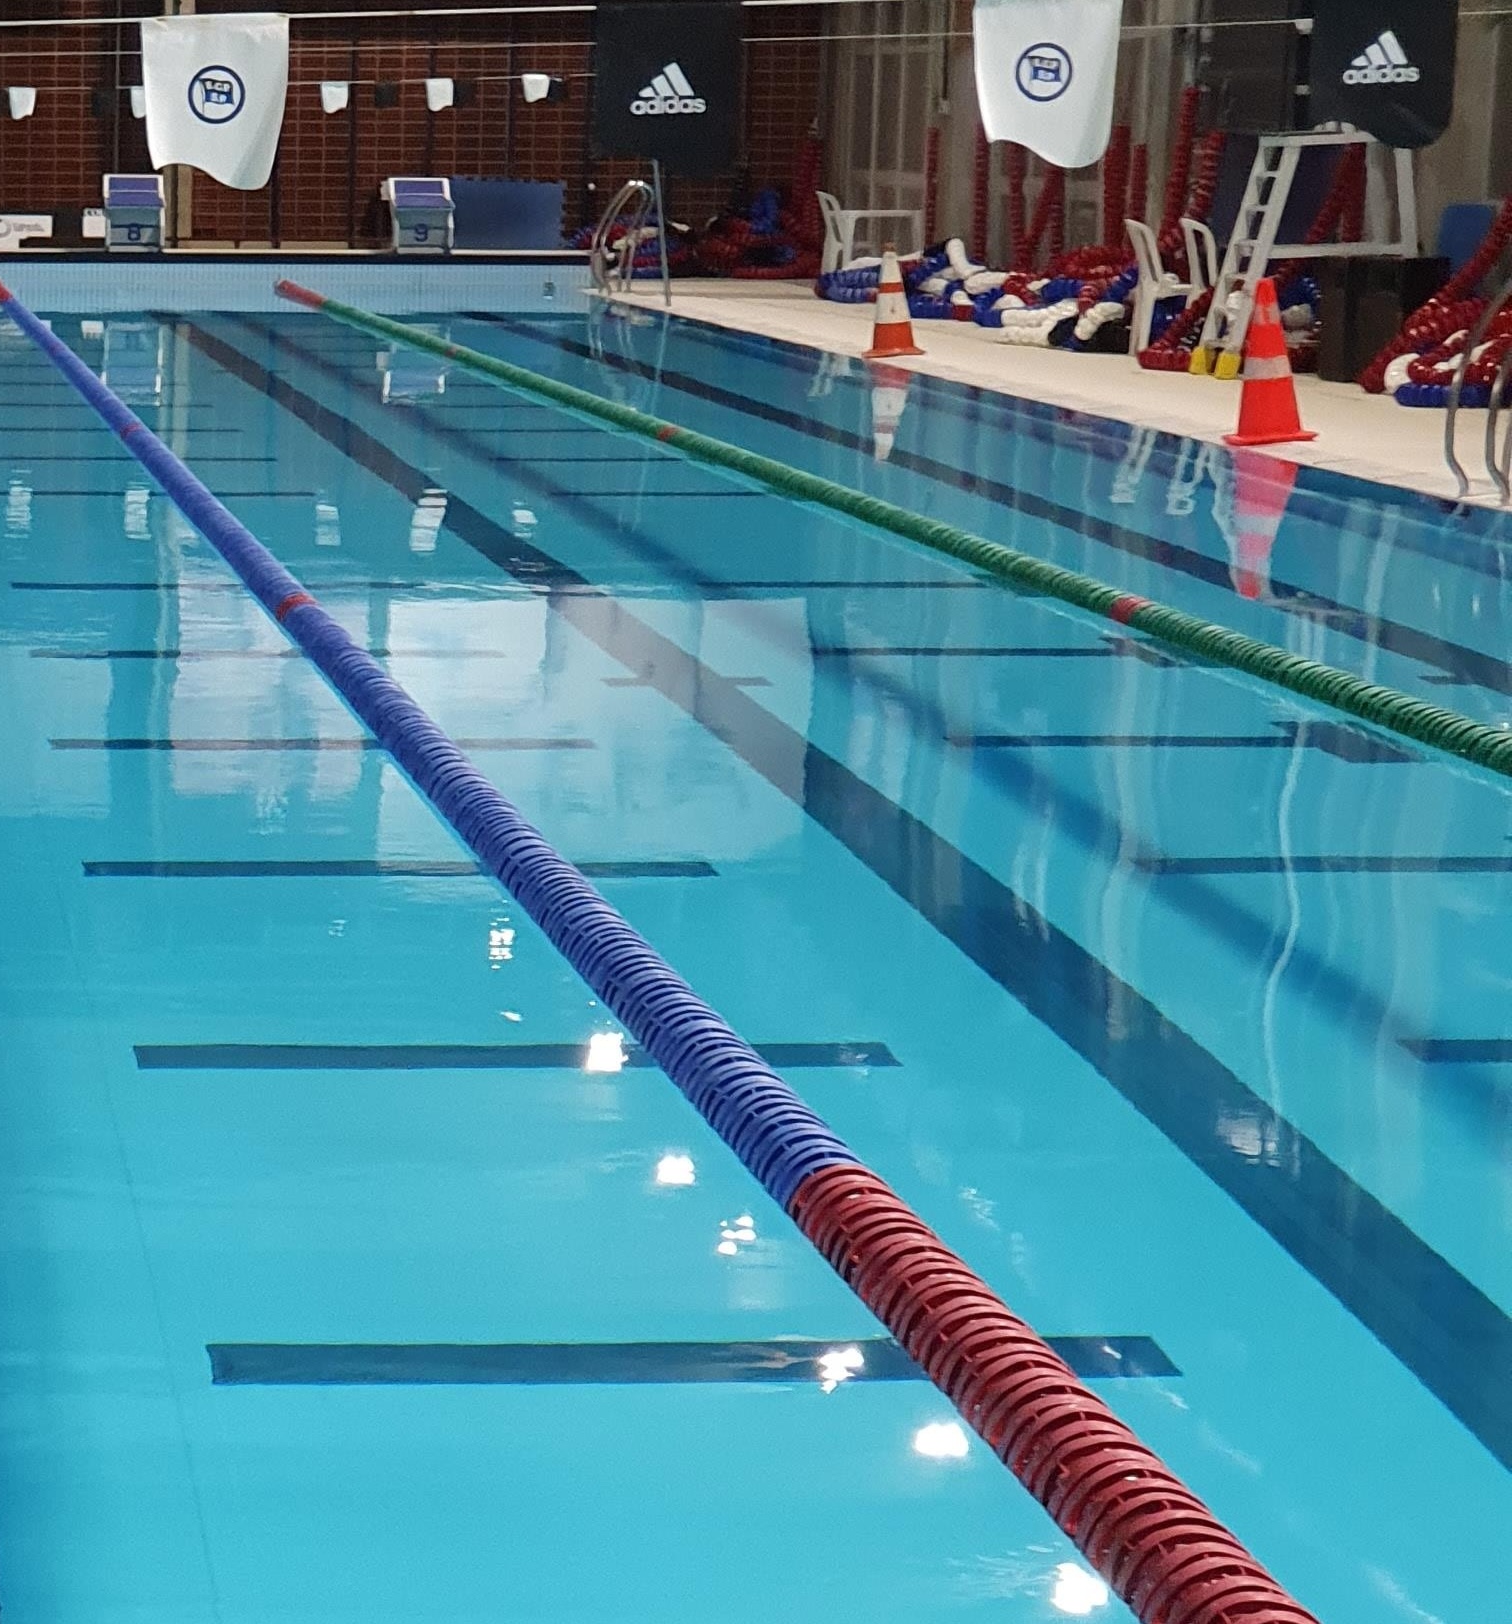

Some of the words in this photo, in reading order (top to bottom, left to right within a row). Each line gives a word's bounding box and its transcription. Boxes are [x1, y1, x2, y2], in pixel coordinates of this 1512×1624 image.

[1342, 66, 1421, 86] adidas
[630, 95, 707, 116] adidas
[128, 223, 141, 241] 8
[414, 223, 428, 242] 9
